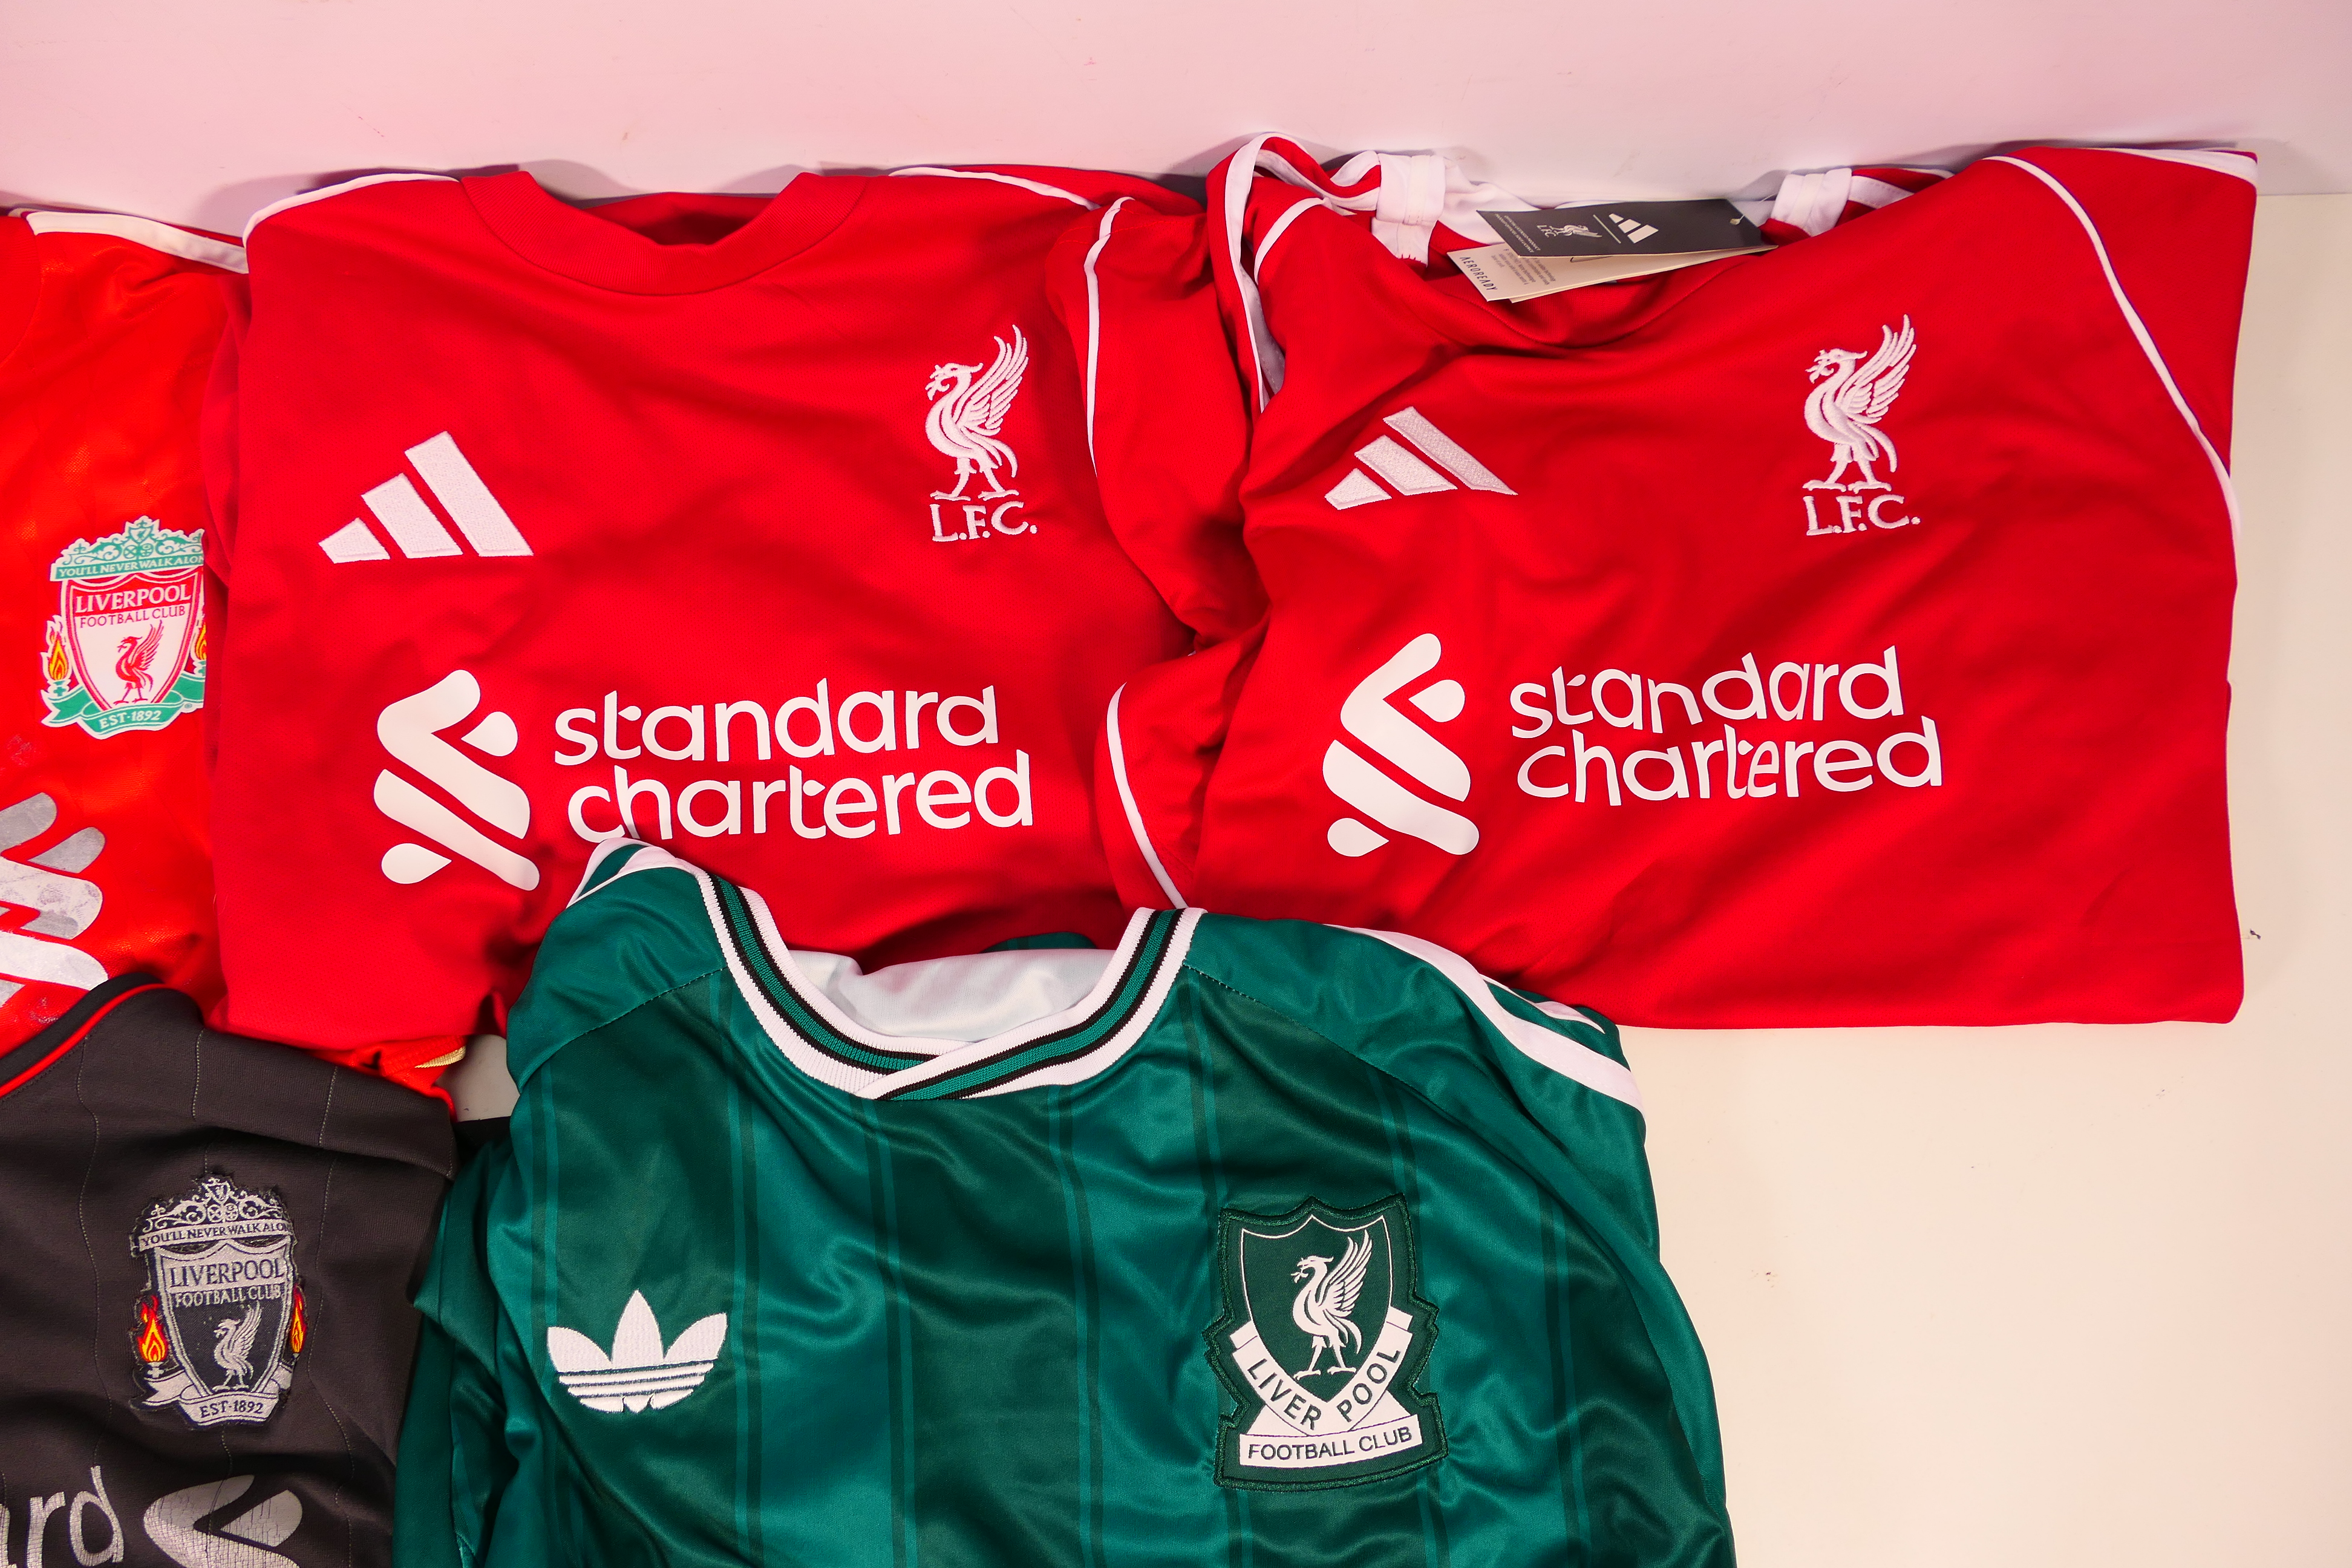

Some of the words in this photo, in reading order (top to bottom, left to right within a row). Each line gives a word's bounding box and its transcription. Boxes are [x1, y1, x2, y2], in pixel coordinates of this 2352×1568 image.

[1459, 256, 1498, 290] AEROREADY
[929, 500, 1037, 542] L.F.C.
[1803, 494, 1921, 536] L.F.C.
[59, 566, 97, 577] YOU'LL
[100, 561, 138, 573] NEVER
[138, 557, 173, 570] WALK
[75, 584, 191, 613] LIVERPOOL
[80, 610, 149, 629] FOOTBALL
[152, 606, 186, 619] CLUB
[1510, 645, 1904, 739] standard
[554, 678, 999, 766] standard
[1517, 715, 1942, 806] chartered
[567, 749, 1033, 843] chartered
[141, 1232, 188, 1246] YOU'LL
[188, 1227, 226, 1238] NEVER
[227, 1224, 263, 1235] WALK
[169, 1258, 285, 1287] LIVERPOOL
[175, 1288, 246, 1307] FOOTBALL
[248, 1284, 281, 1300] CLUB
[1247, 1358, 1322, 1431] LIVER
[1336, 1349, 1401, 1422] POOL
[1248, 1440, 1354, 1460] FOOTBALL
[1358, 1426, 1413, 1452] CLUB
[0, 1466, 124, 1568] rd
